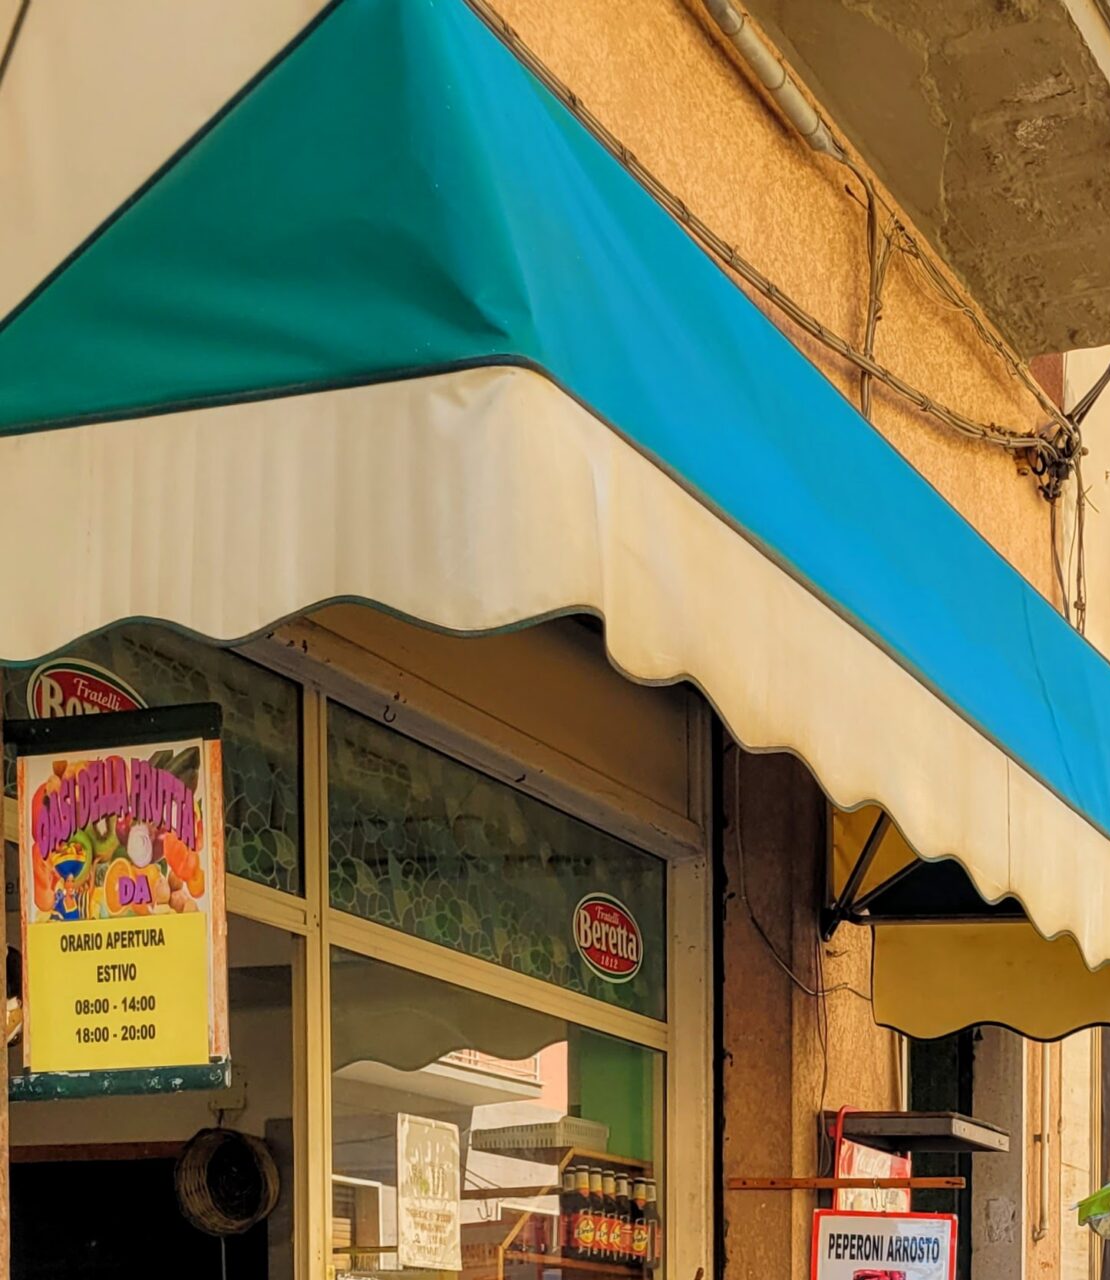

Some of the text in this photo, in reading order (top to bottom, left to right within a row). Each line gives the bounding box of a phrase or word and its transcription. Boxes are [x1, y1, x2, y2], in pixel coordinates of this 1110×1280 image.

[74, 677, 122, 711] Fratelli
[77, 757, 132, 832] DELLA
[129, 757, 196, 851] FRUTTA
[118, 875, 152, 905] DA
[60, 928, 166, 953] ORARIO APERTURA
[579, 908, 638, 962] Beretta
[96, 963, 137, 983] ESTIVO
[600, 954, 619, 970] 1812
[75, 998, 110, 1015] 08:00
[121, 995, 156, 1013] 14:00
[75, 1026, 110, 1043] 18:00
[120, 1024, 156, 1041] 20:00
[828, 1233, 940, 1264] PEPERONI ARROSTO
